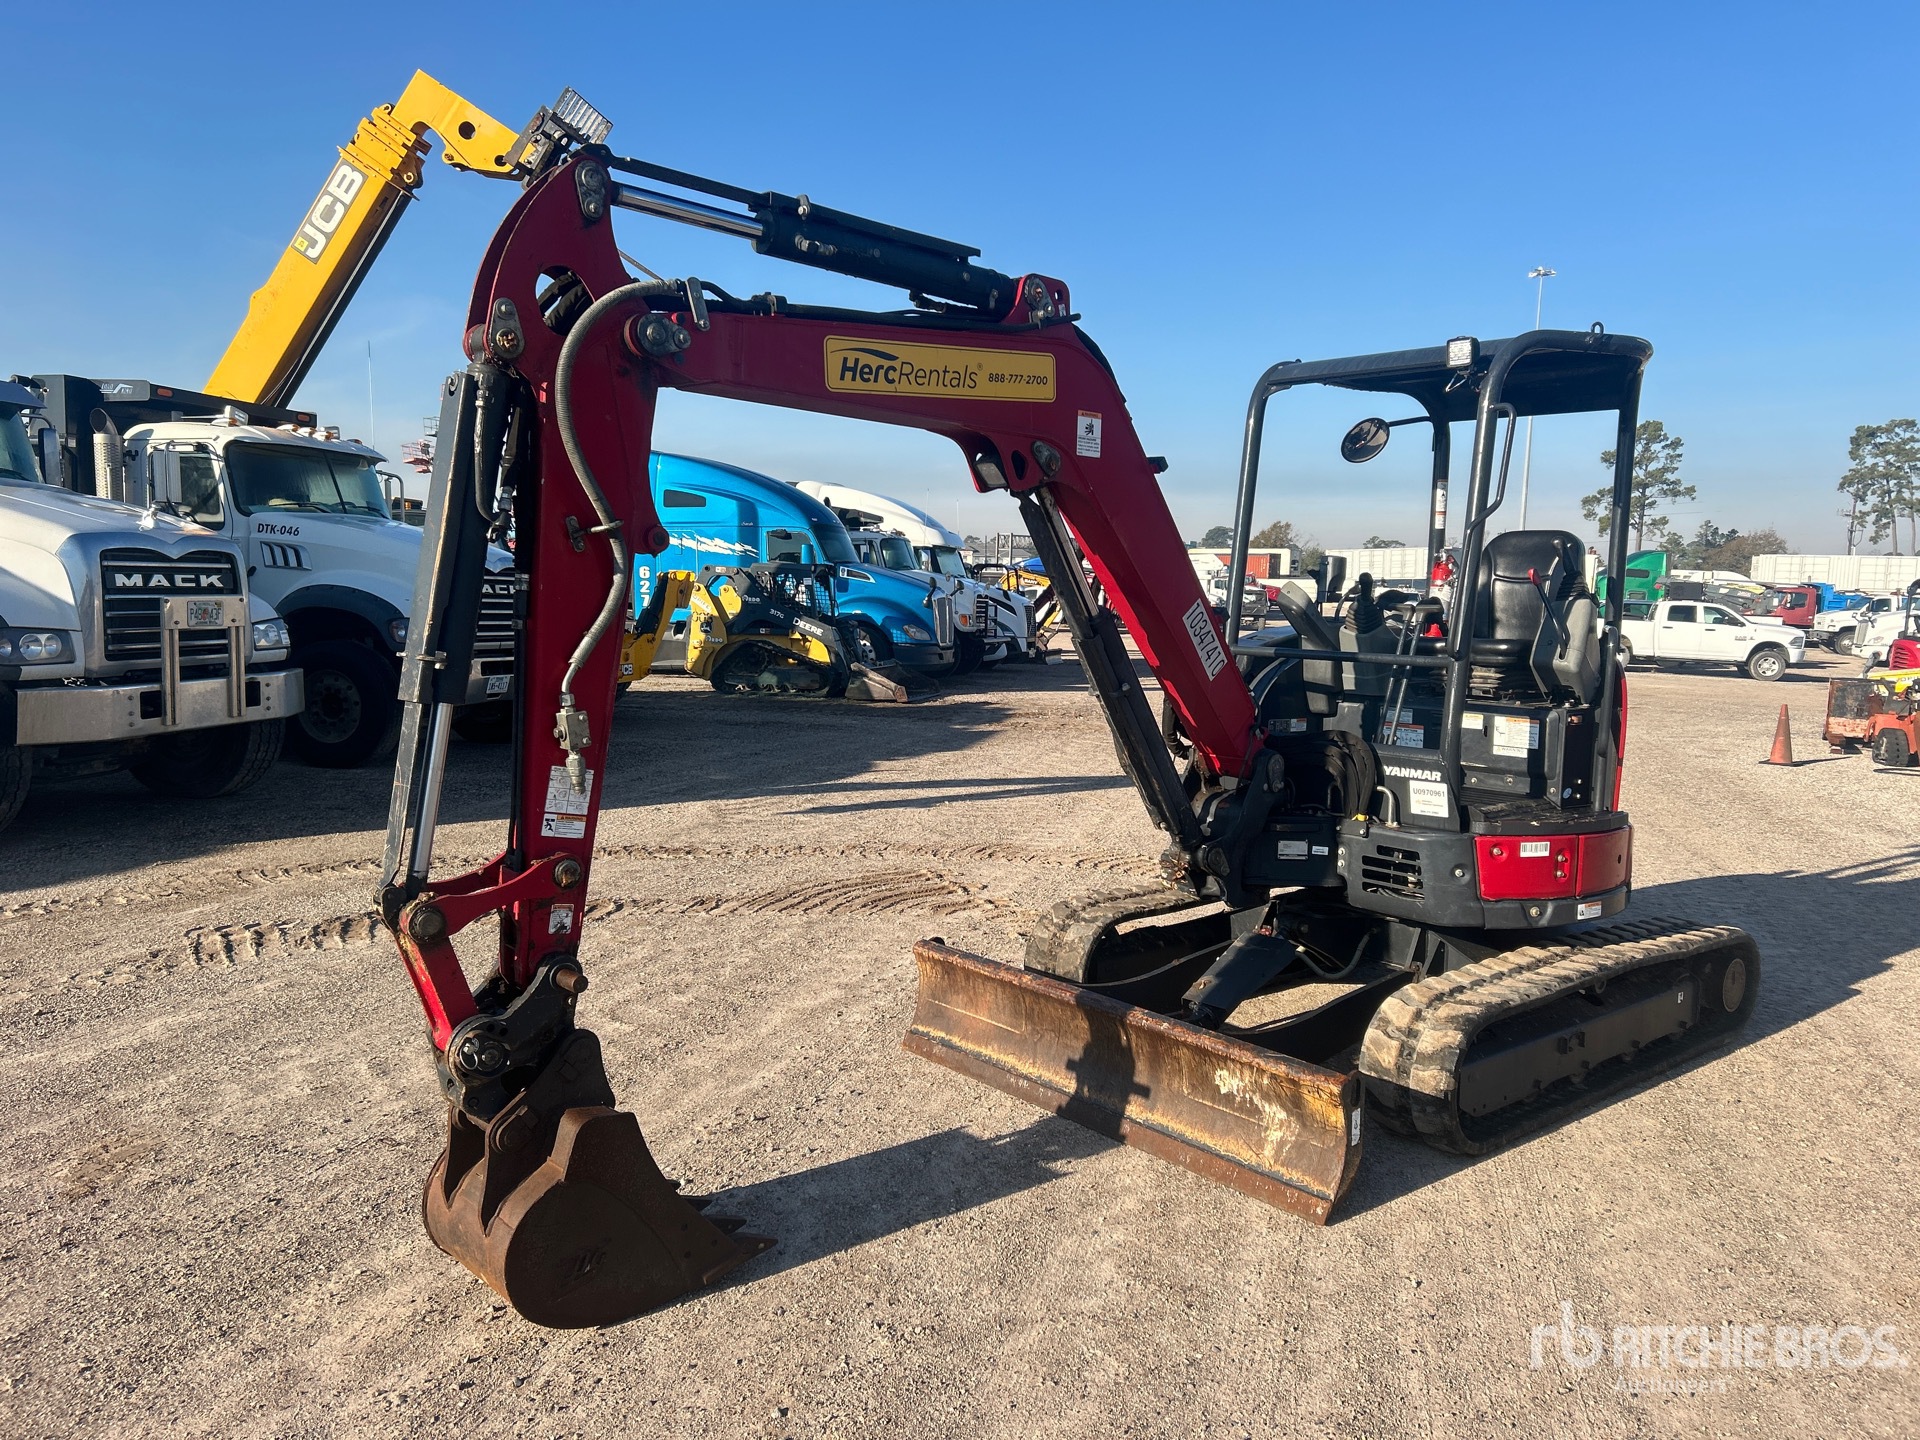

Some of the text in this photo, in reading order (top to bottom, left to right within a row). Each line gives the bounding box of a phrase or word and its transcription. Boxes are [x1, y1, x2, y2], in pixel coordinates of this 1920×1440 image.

[303, 164, 363, 258] JCB
[988, 372, 1048, 386] 888-777-2700
[257, 523, 300, 536] DTK-046
[114, 573, 224, 587] MACK
[638, 566, 650, 607] 627
[769, 608, 784, 619] 317G
[793, 617, 824, 637] DEERE
[1186, 602, 1225, 677] 10347410
[1383, 765, 1442, 781] YANMAR
[1413, 788, 1445, 797] U0970961
